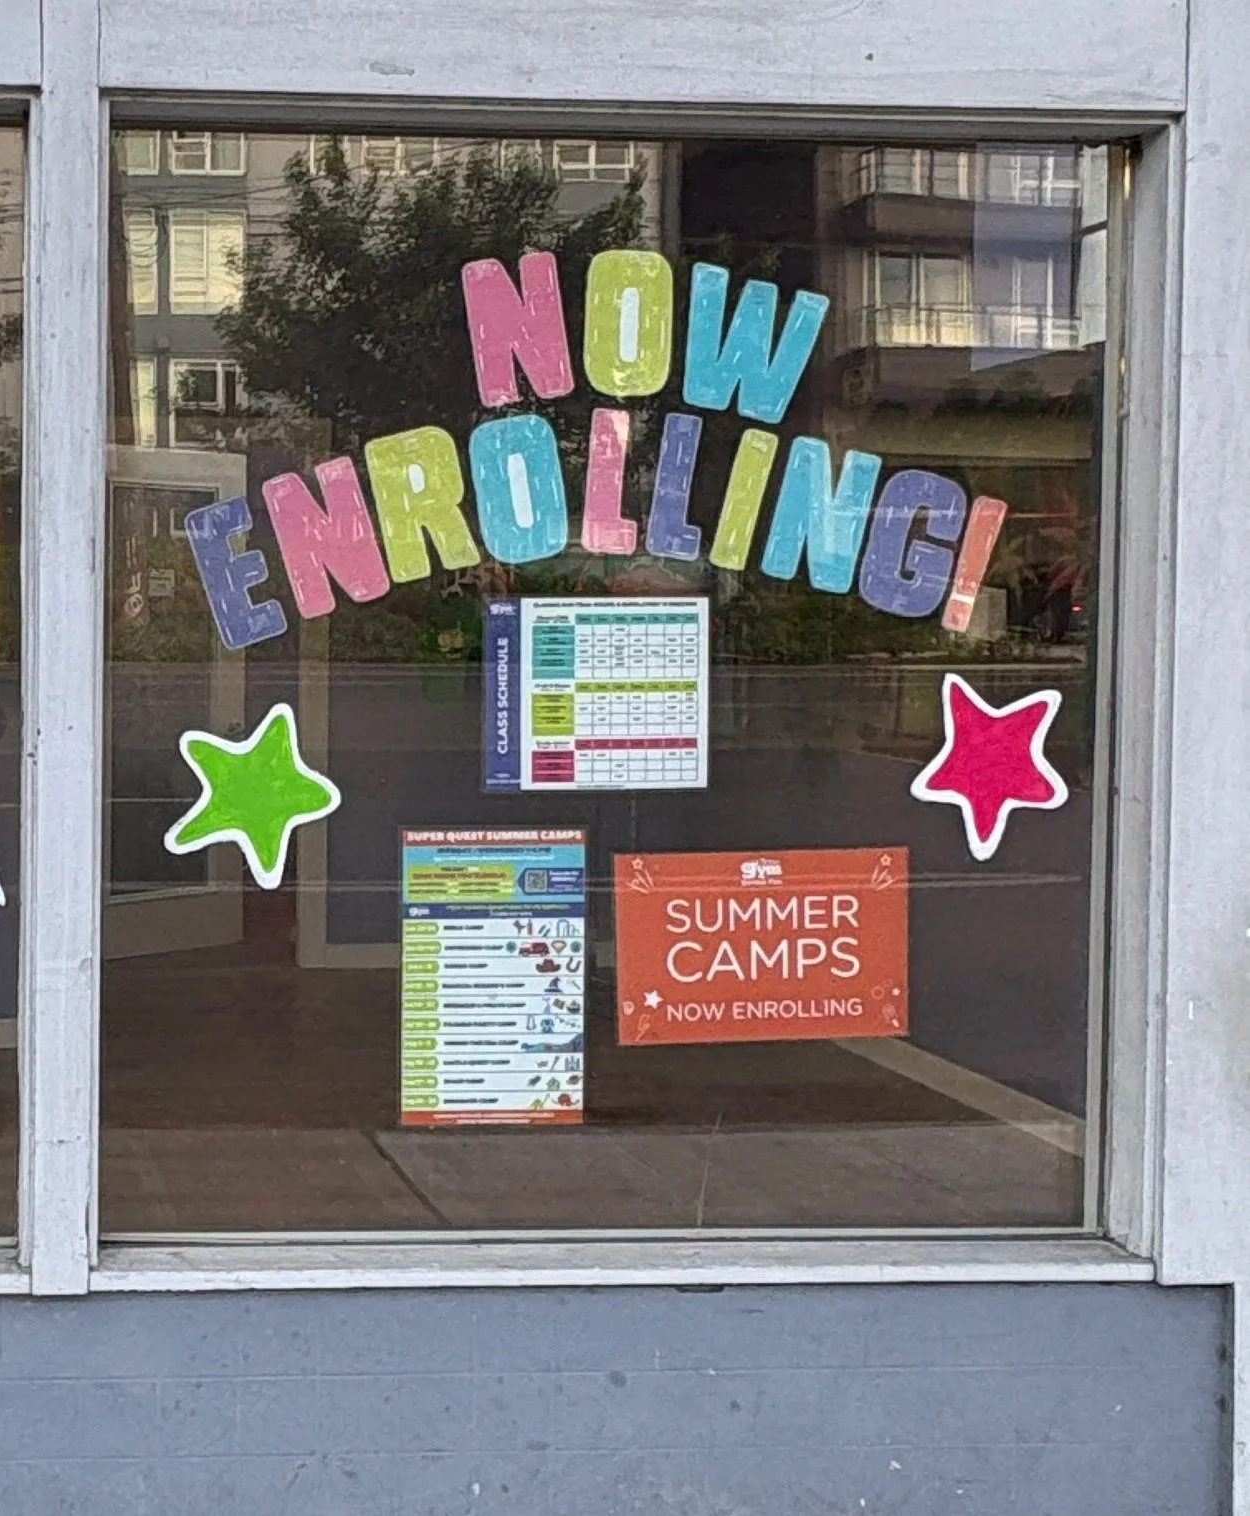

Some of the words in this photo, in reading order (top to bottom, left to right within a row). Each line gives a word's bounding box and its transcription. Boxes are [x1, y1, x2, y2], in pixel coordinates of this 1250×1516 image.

[462, 249, 830, 425] NOW
[183, 408, 1007, 650] ENROLLING!
[497, 637, 509, 708] SCHEDULE
[497, 710, 509, 754] CLASS
[406, 832, 444, 842] SUPER
[446, 831, 484, 843] QUEST
[487, 831, 539, 841] SUMMER
[541, 830, 582, 840] CAMPS
[665, 895, 859, 933] SUMMER
[666, 937, 860, 983] CAMPS
[666, 1002, 726, 1022] NOW
[732, 998, 863, 1021] ENROLLING
